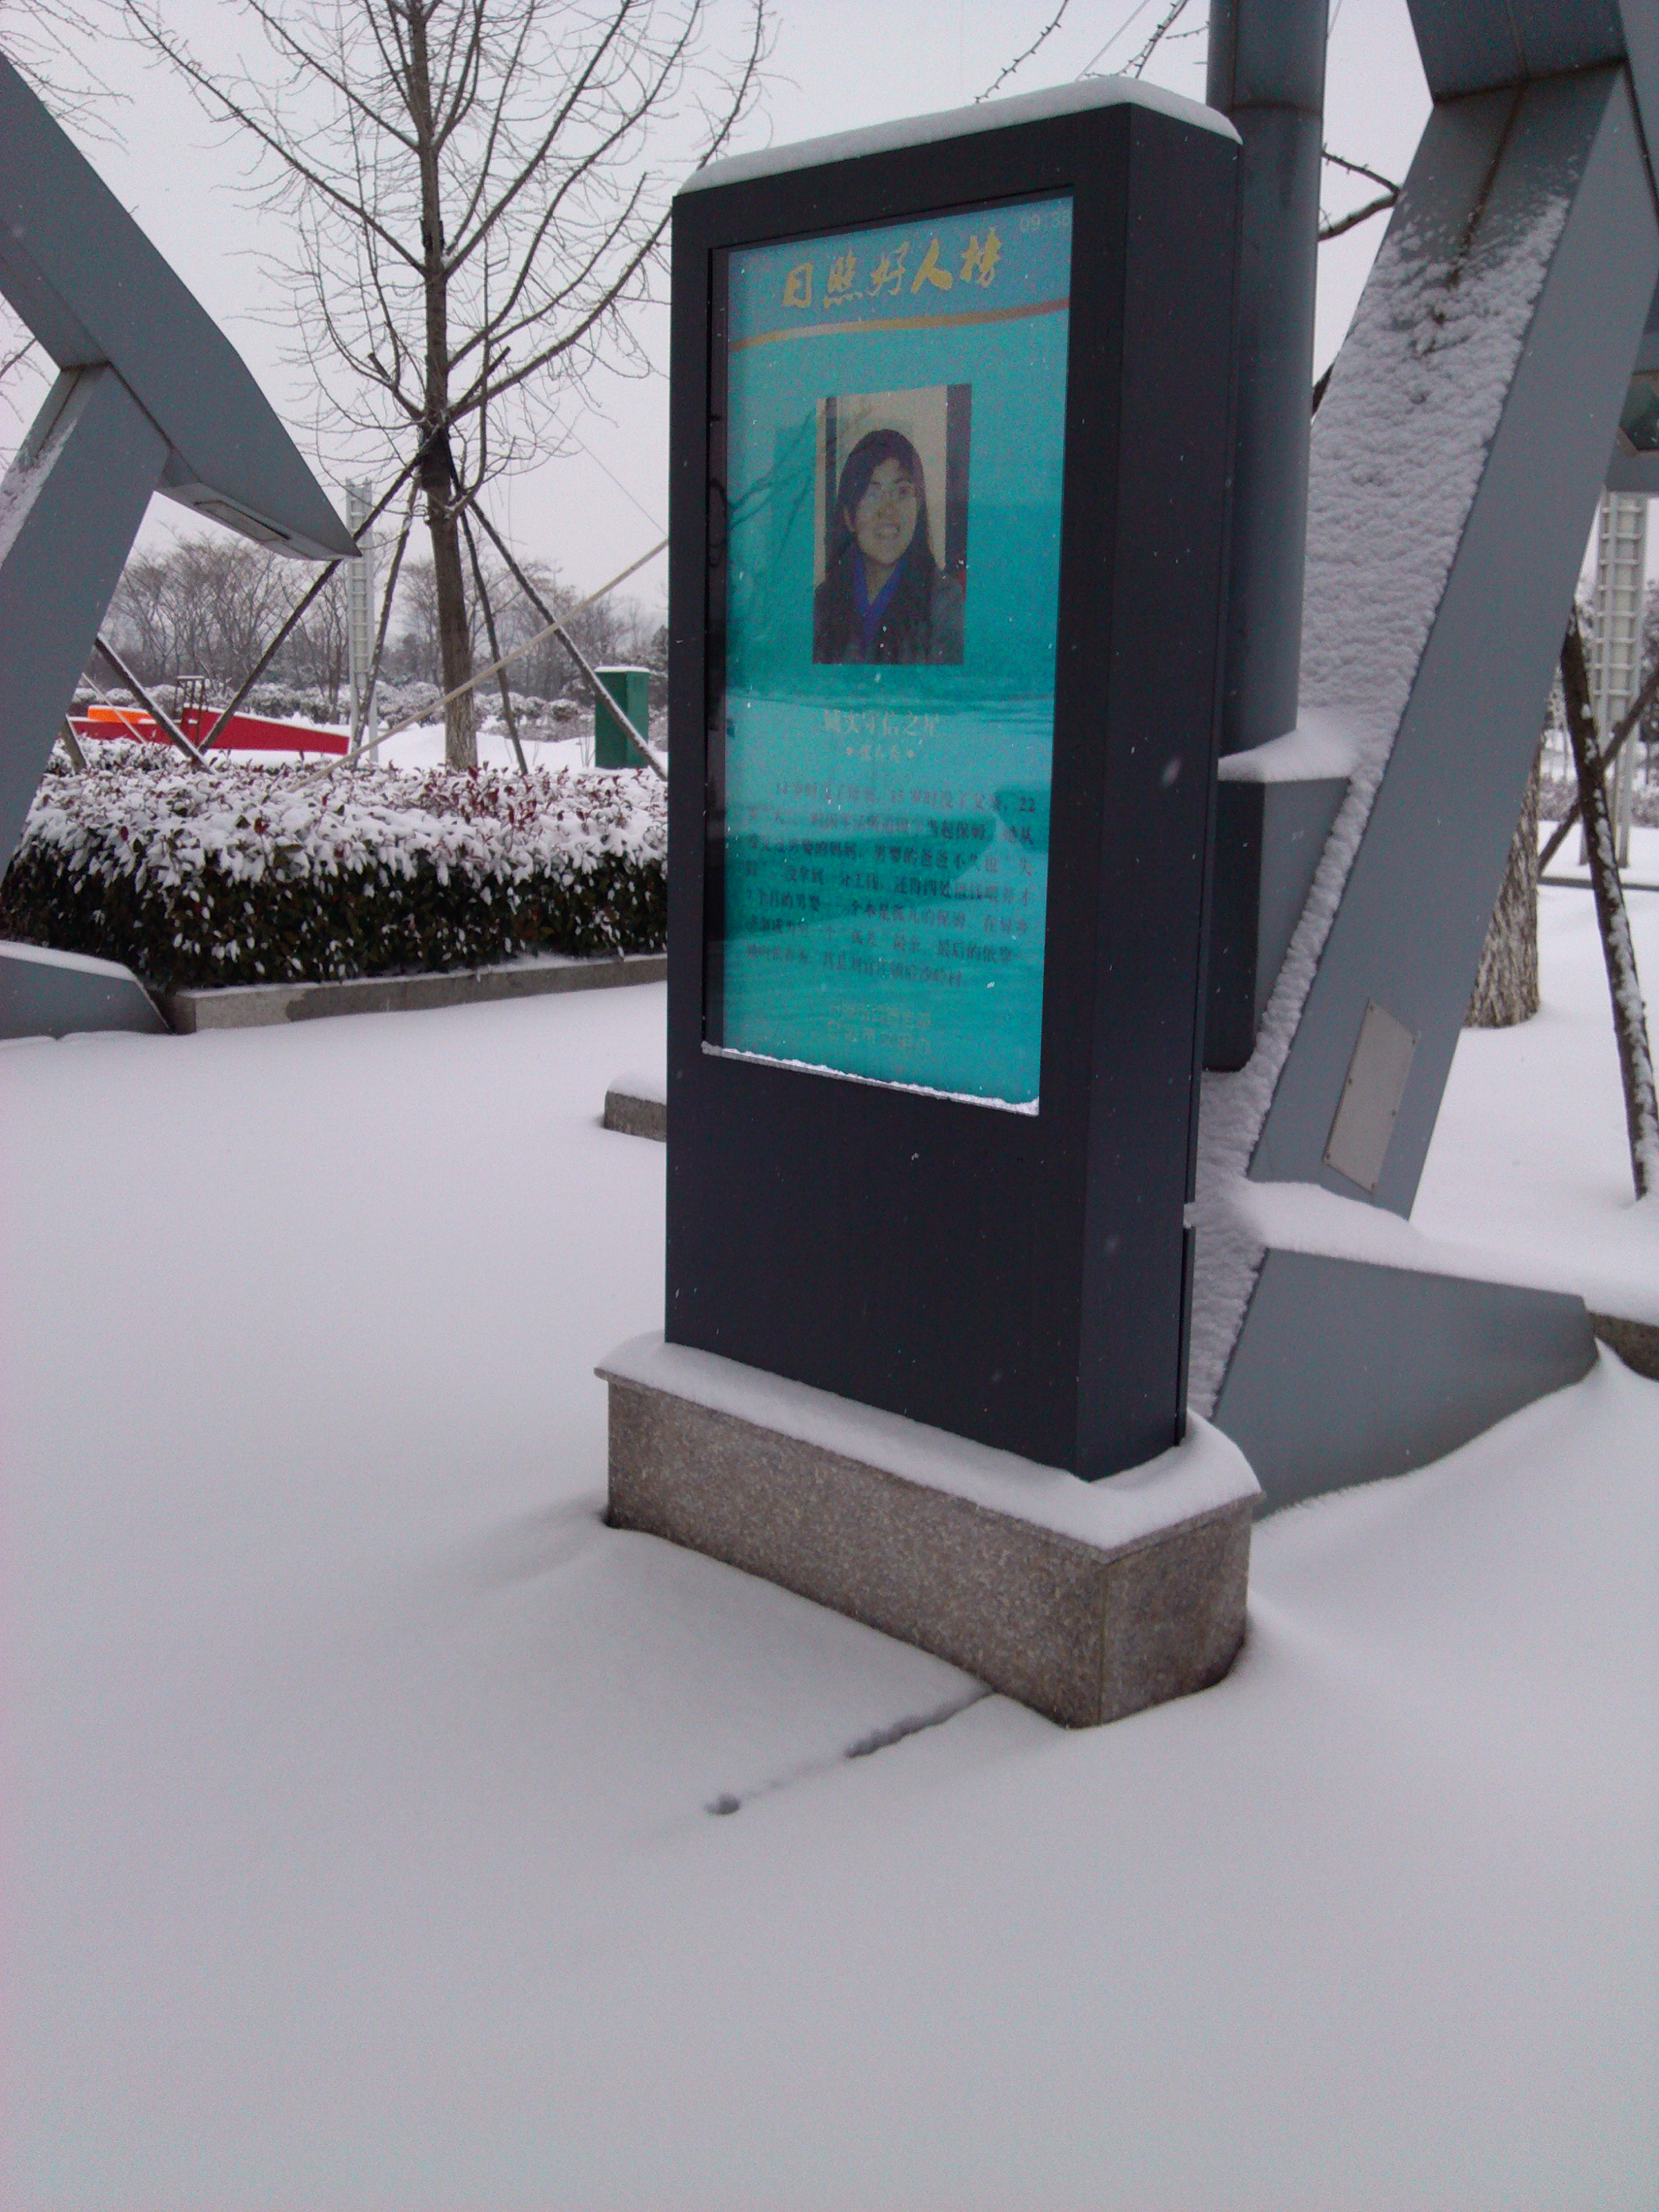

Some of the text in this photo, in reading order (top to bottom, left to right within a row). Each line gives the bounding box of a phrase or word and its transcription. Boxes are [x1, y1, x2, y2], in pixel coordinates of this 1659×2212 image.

[782, 227, 1003, 309] 日照好人榜
